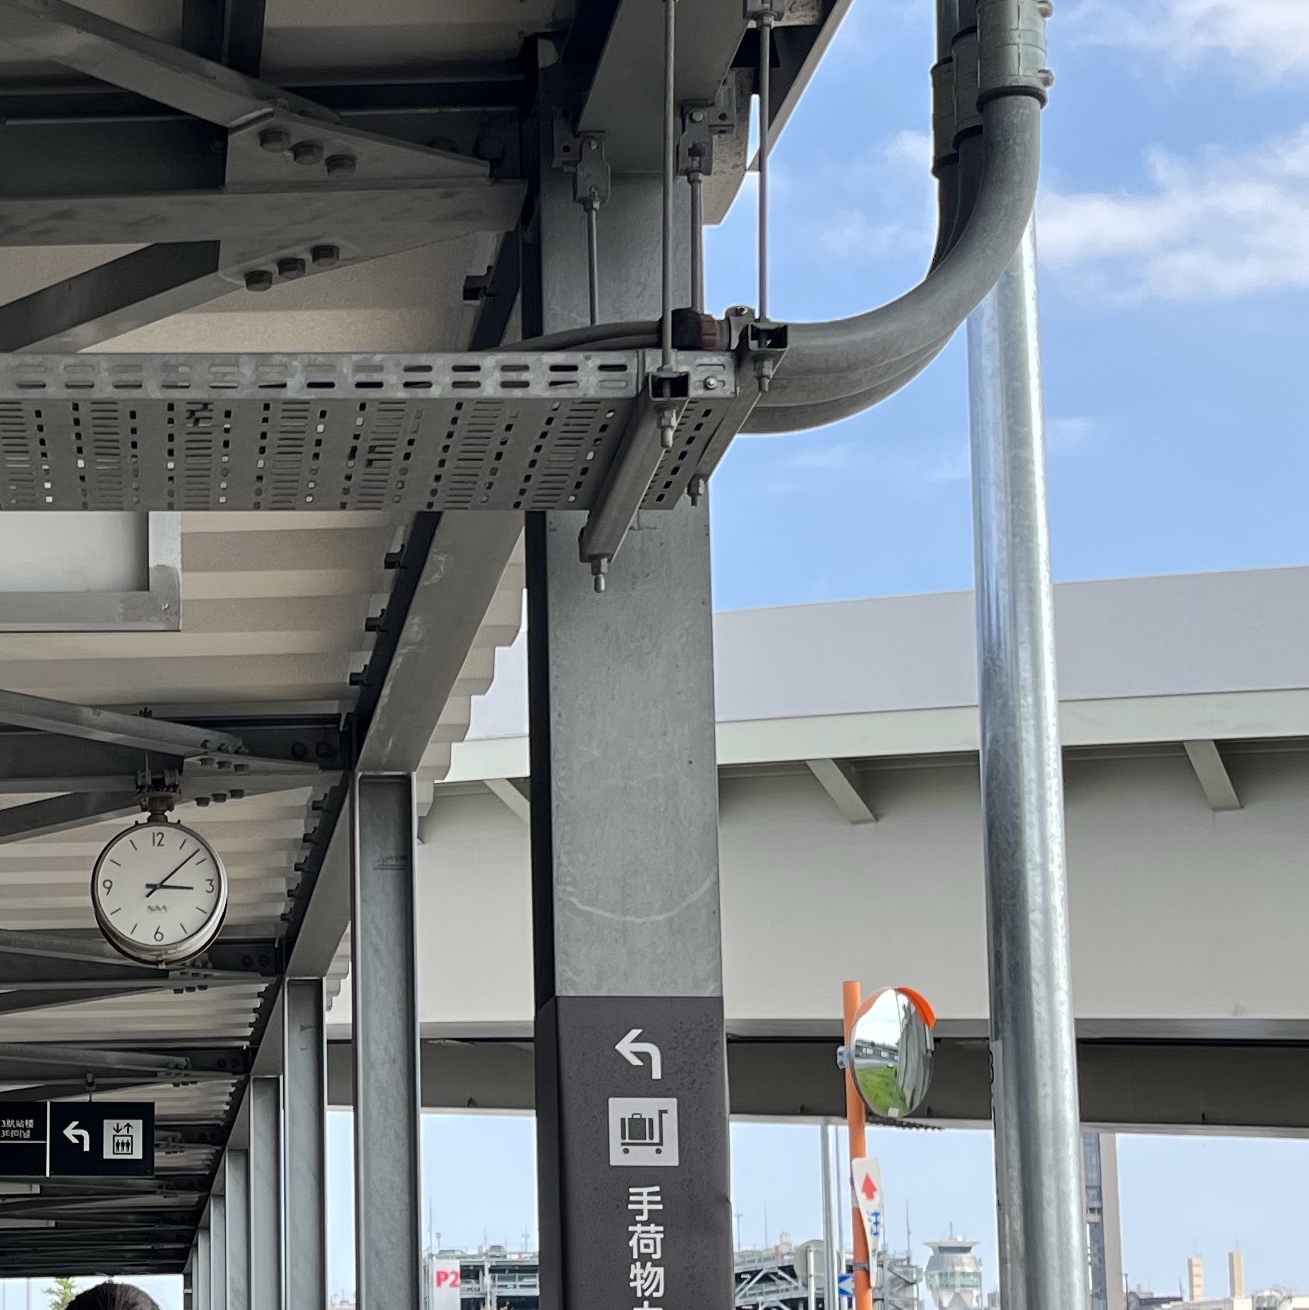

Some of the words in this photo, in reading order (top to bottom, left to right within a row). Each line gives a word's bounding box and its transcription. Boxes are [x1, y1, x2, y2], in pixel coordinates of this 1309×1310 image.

[152, 831, 165, 848] 12
[102, 879, 113, 896] 9
[205, 878, 215, 894] 3
[153, 925, 164, 942] 6
[435, 1270, 461, 1288] P2
